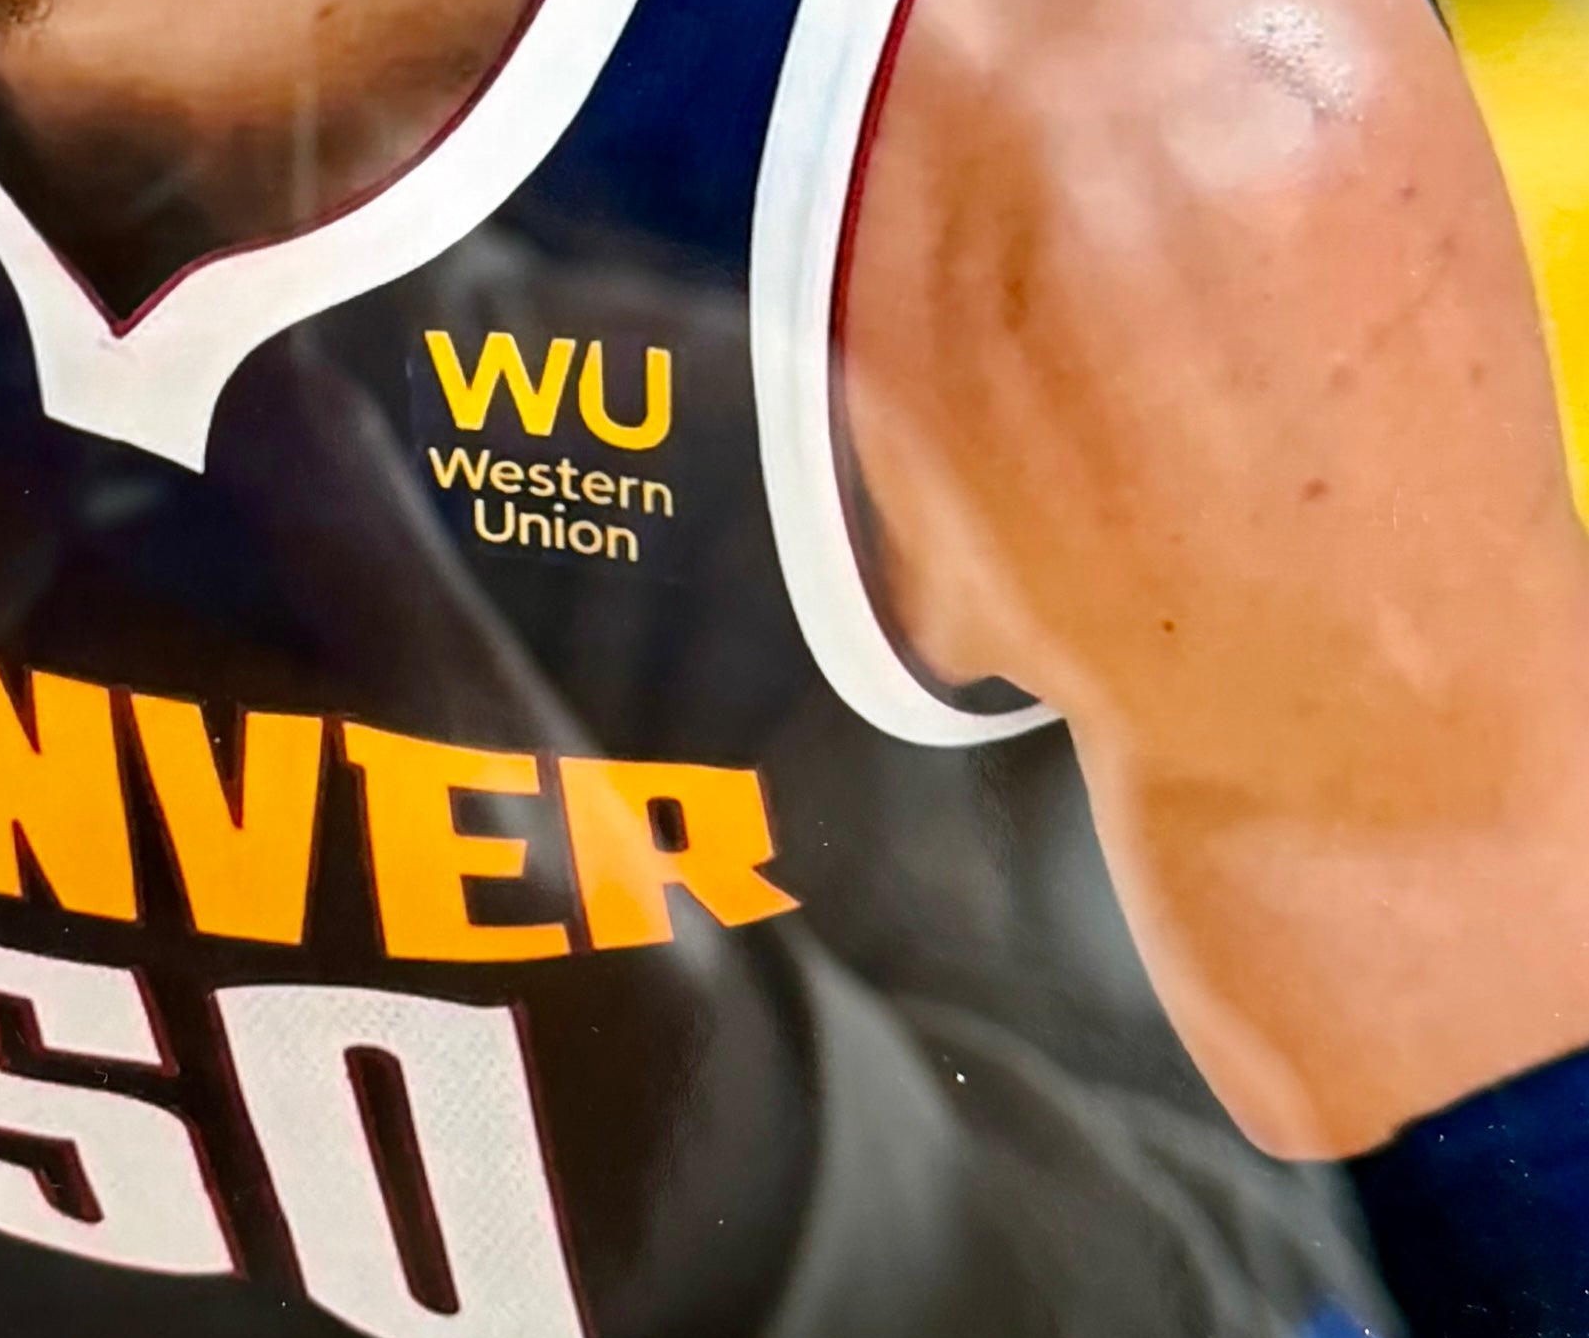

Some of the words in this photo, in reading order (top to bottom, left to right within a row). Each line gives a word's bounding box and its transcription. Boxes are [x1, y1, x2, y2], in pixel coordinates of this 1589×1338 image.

[424, 330, 671, 450] WU
[428, 447, 674, 517] Western
[474, 498, 639, 563] Union
